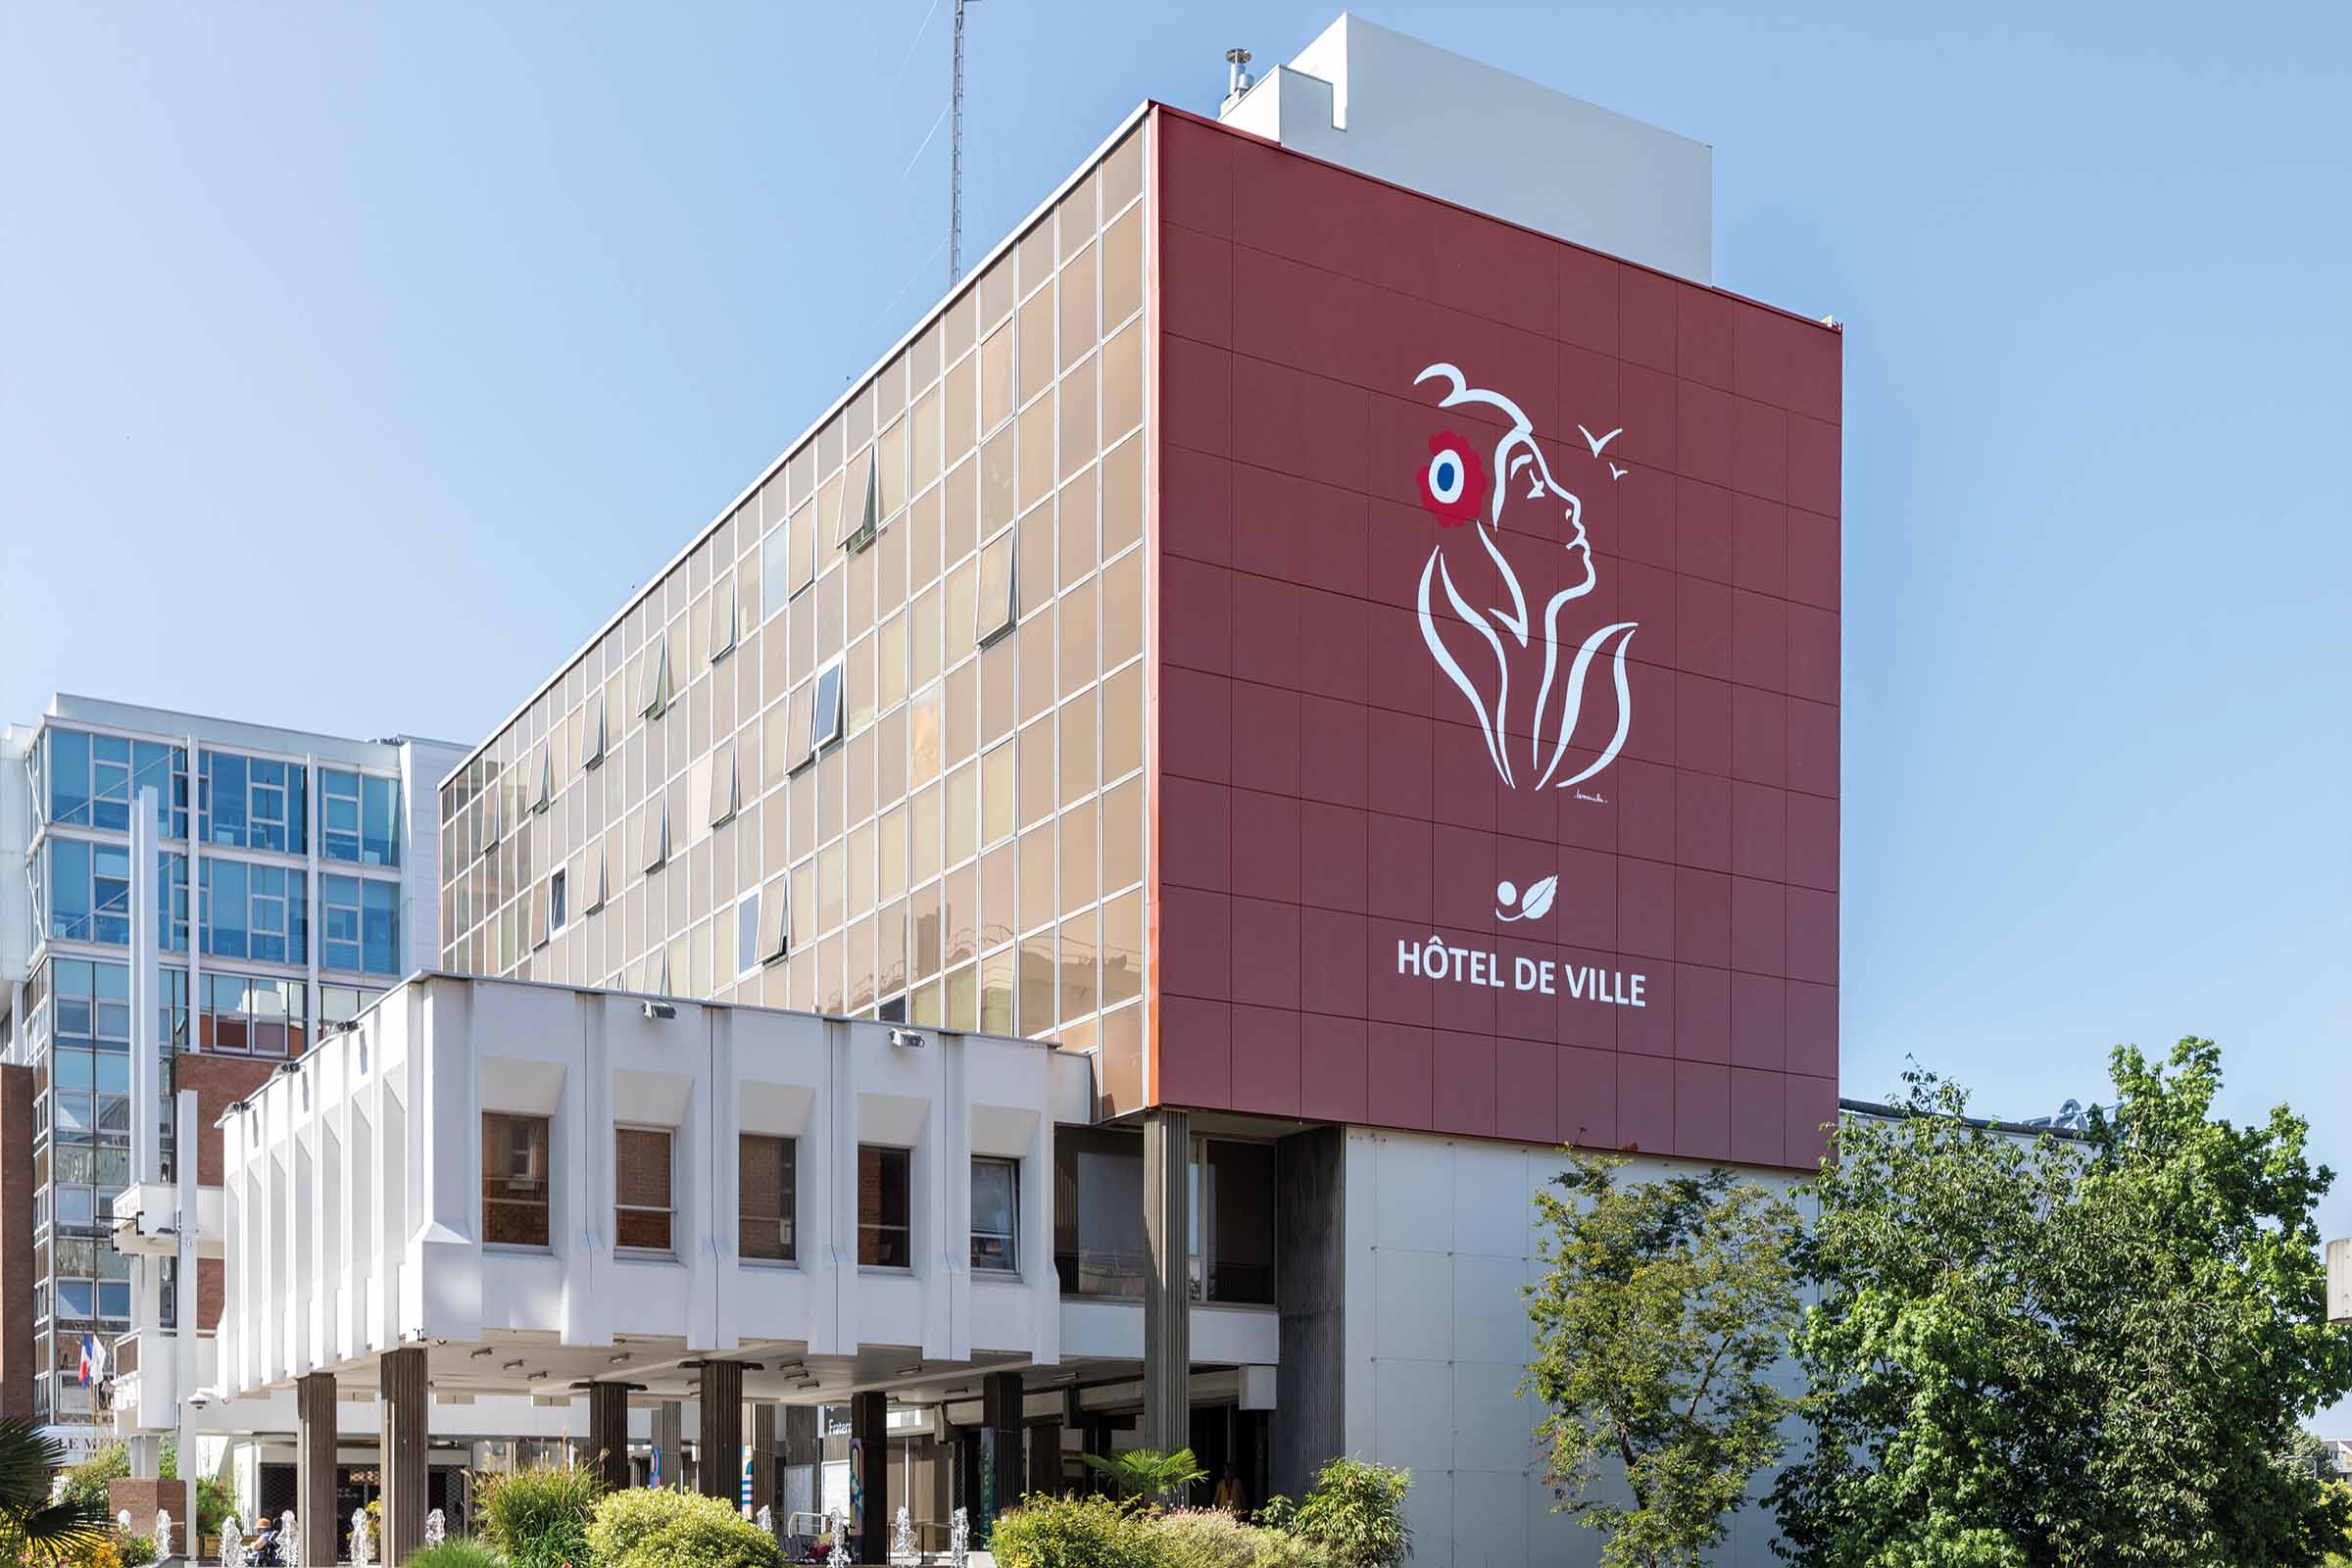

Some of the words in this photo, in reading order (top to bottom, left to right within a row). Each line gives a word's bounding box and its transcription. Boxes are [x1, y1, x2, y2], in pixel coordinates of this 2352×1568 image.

[1397, 935, 1505, 988] HÔTEL
[1515, 956, 1555, 995] DE
[1564, 963, 1646, 1007] VILLE
